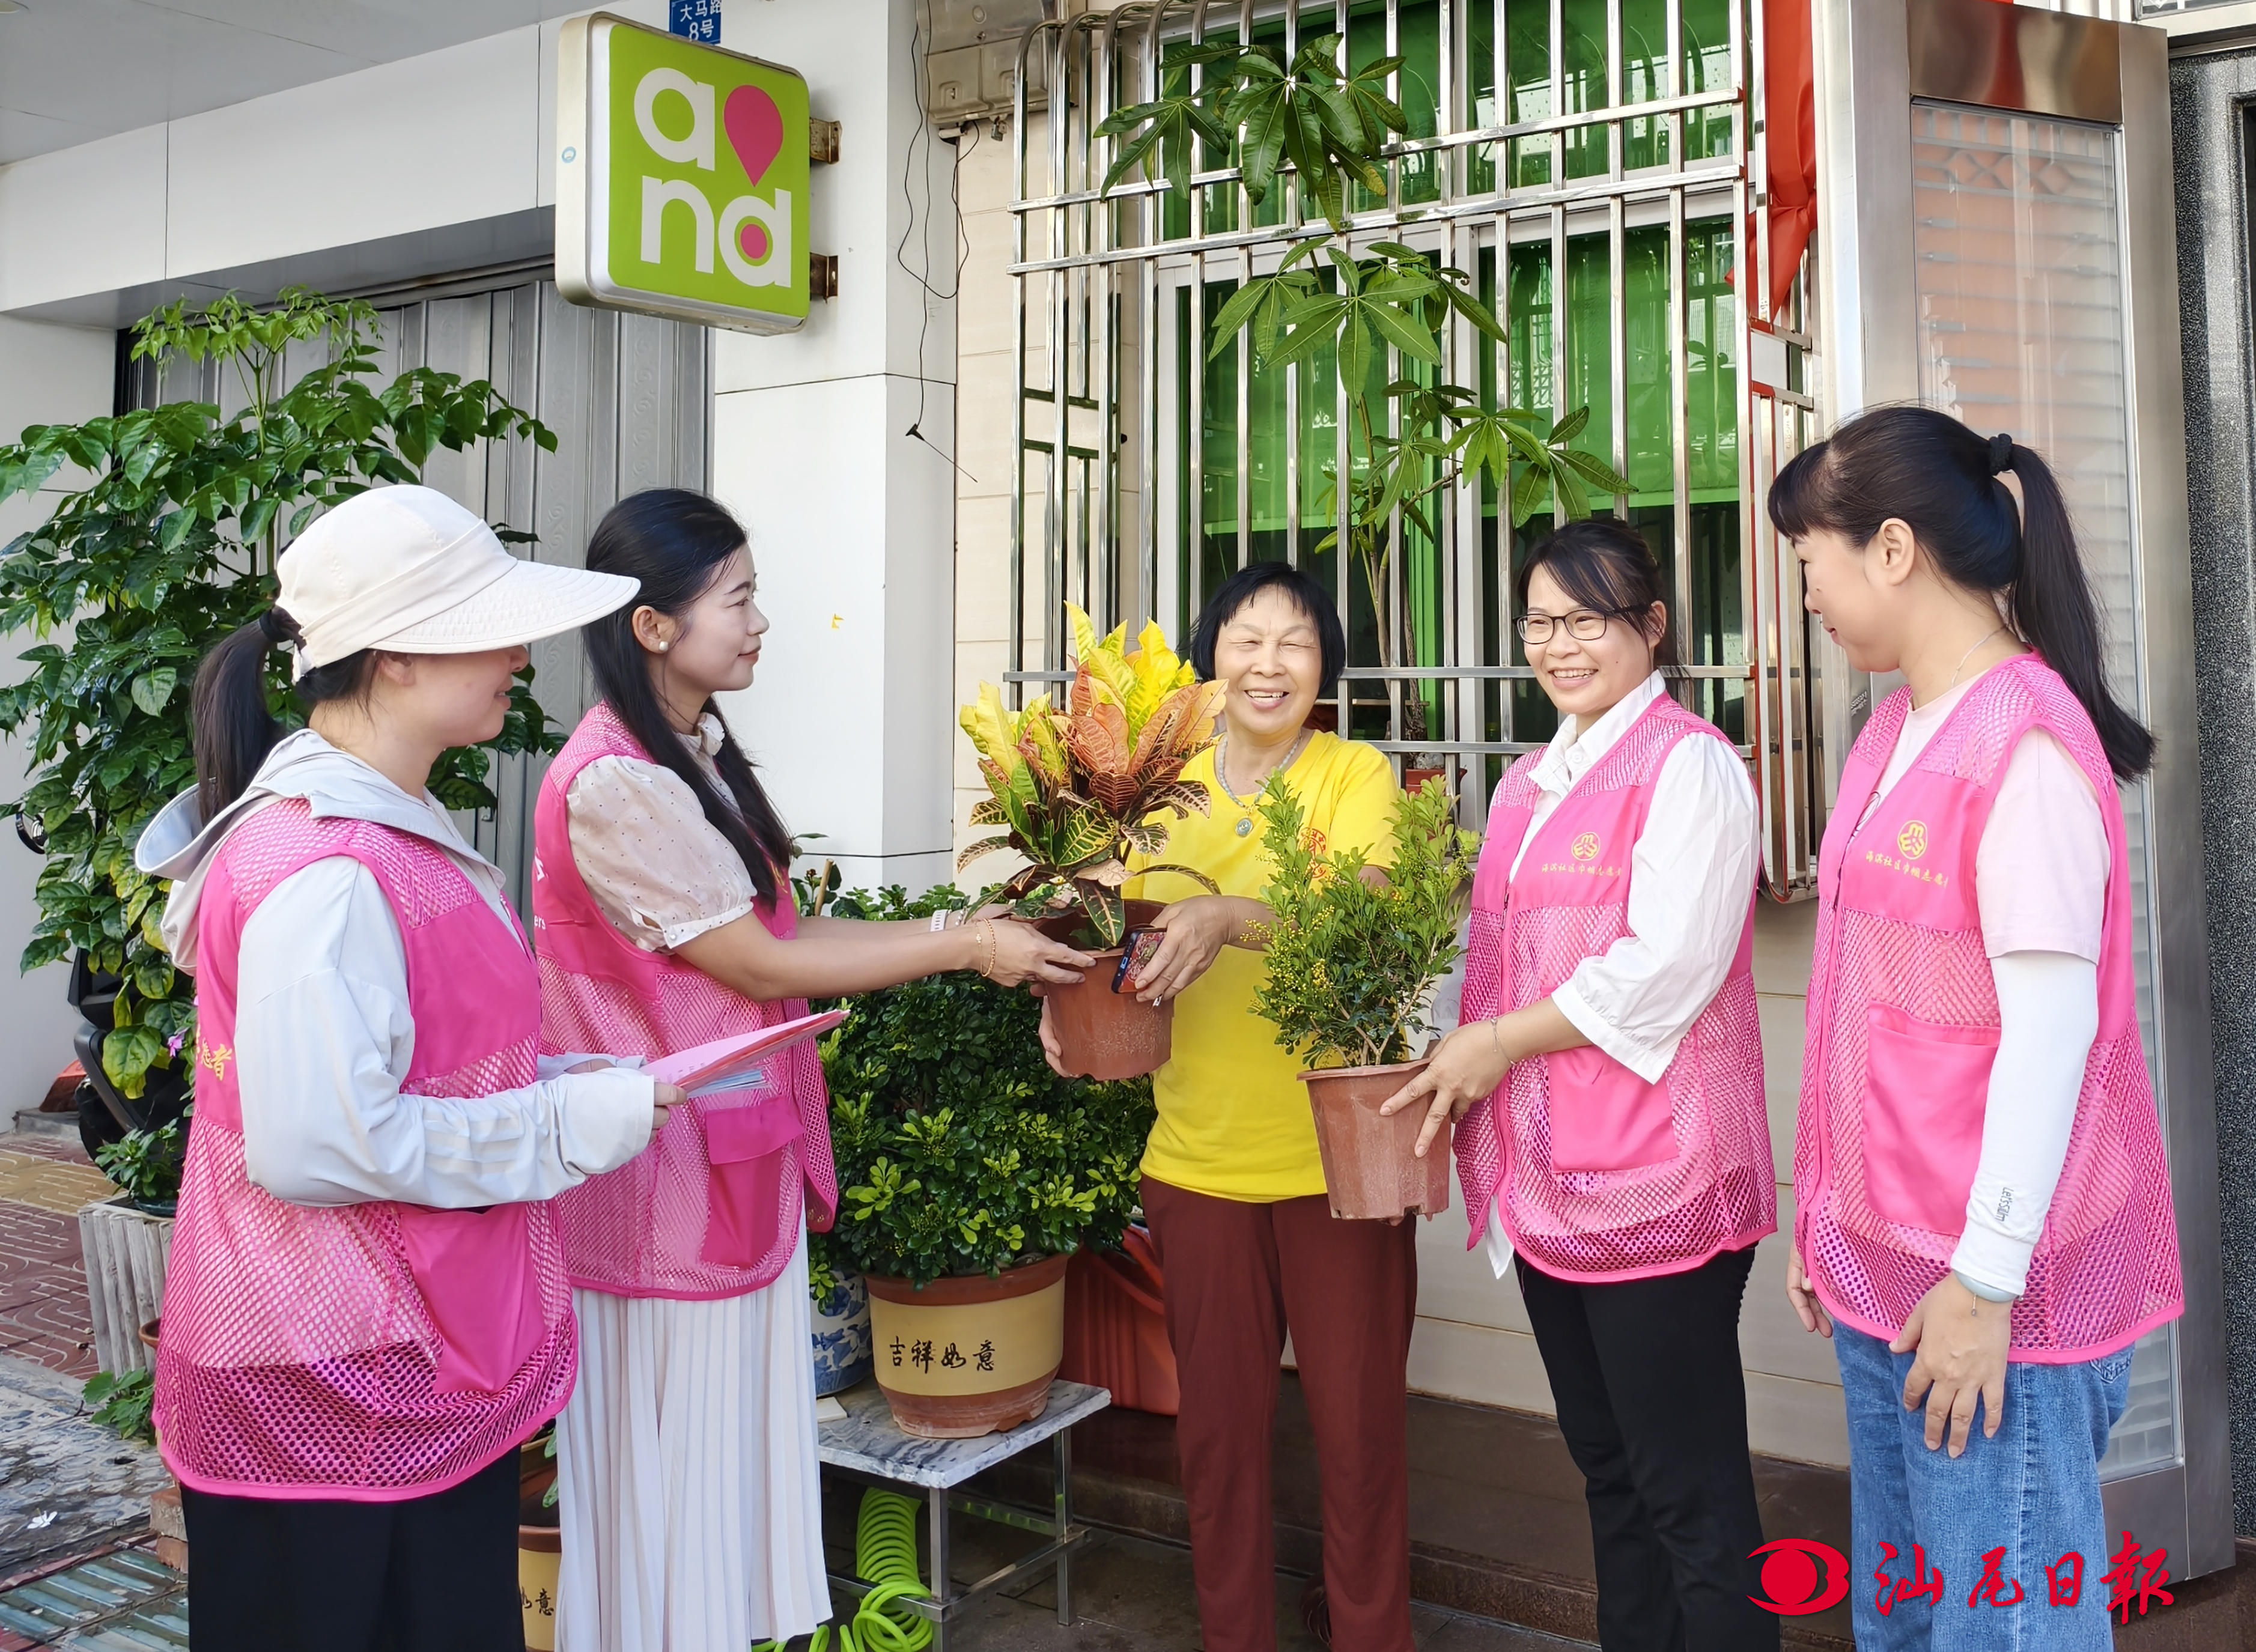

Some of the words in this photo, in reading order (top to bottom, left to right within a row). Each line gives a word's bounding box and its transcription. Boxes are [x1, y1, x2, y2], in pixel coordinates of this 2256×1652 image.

[680, 0, 722, 22] 大马路
[689, 19, 714, 41] 8号
[889, 1335, 996, 1374] 吉祥如意
